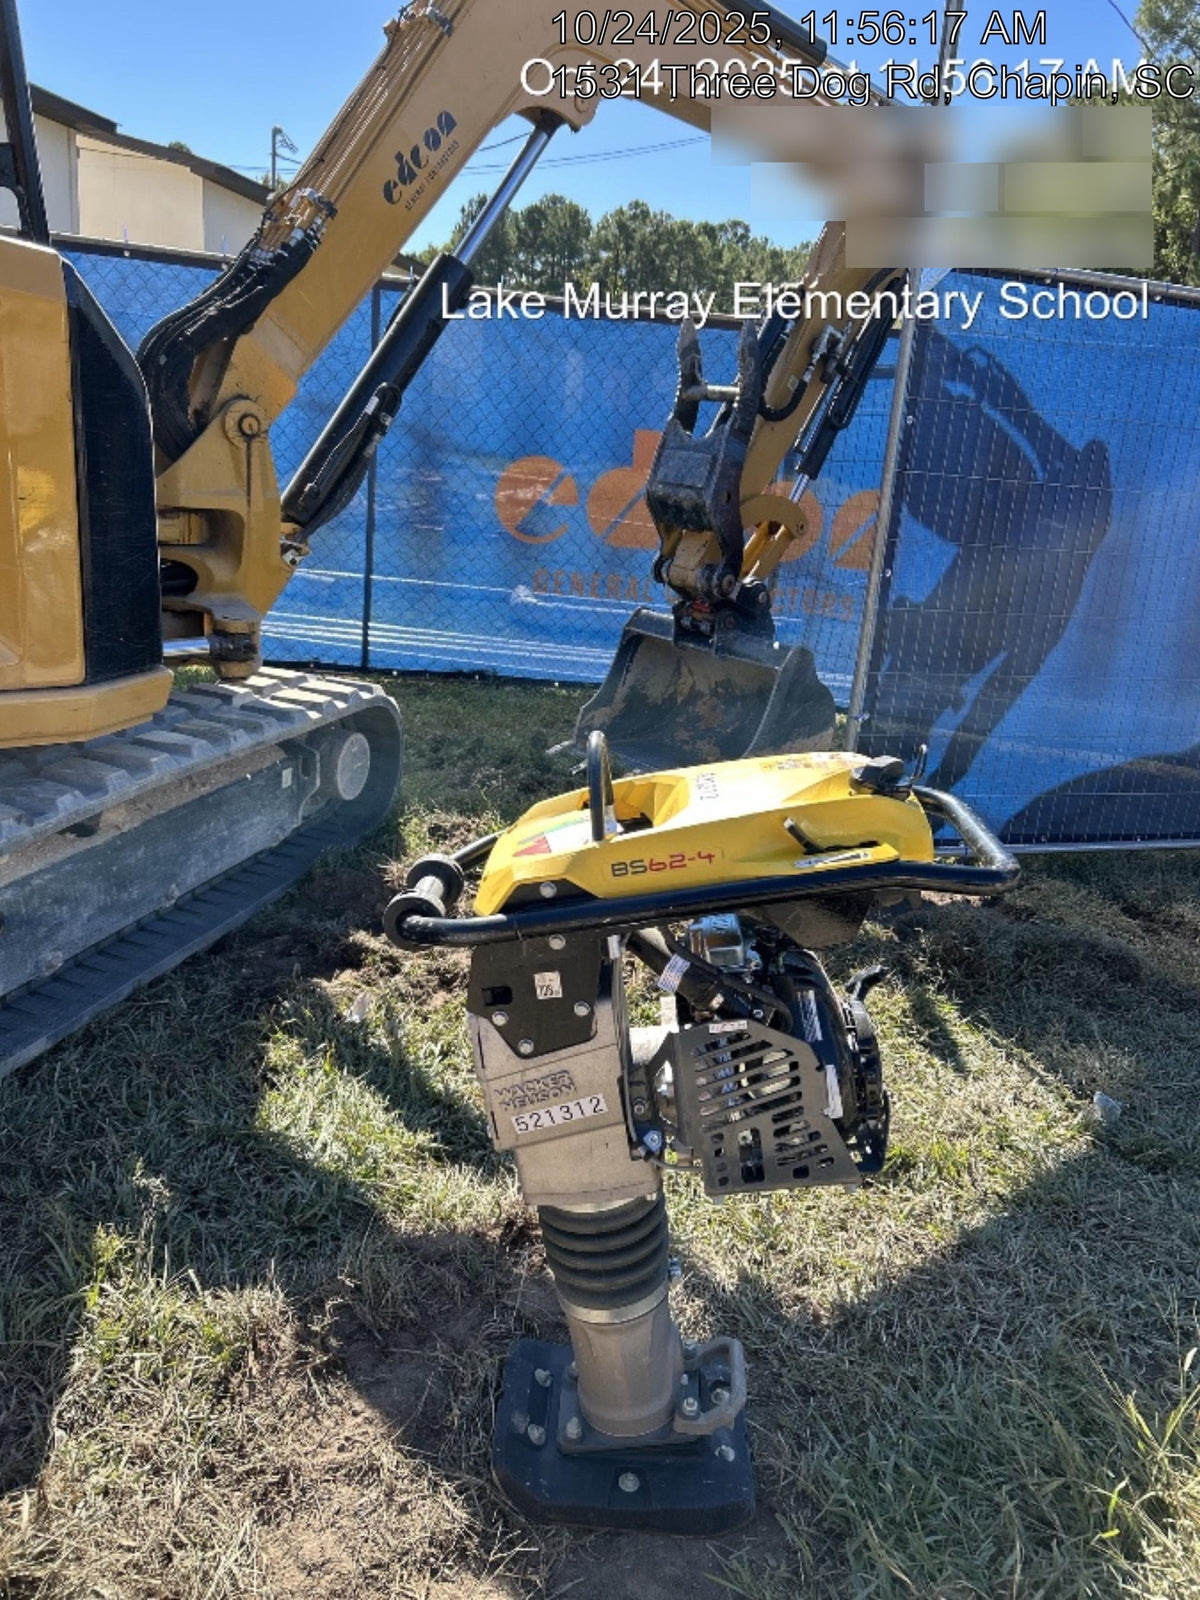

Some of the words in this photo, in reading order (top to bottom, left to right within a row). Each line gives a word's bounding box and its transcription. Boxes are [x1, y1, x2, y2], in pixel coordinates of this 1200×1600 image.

[533, 567, 653, 601] GENERAL
[611, 850, 716, 877] BS62-4
[494, 1069, 574, 1096] WACKER
[514, 1096, 604, 1132] 521312
